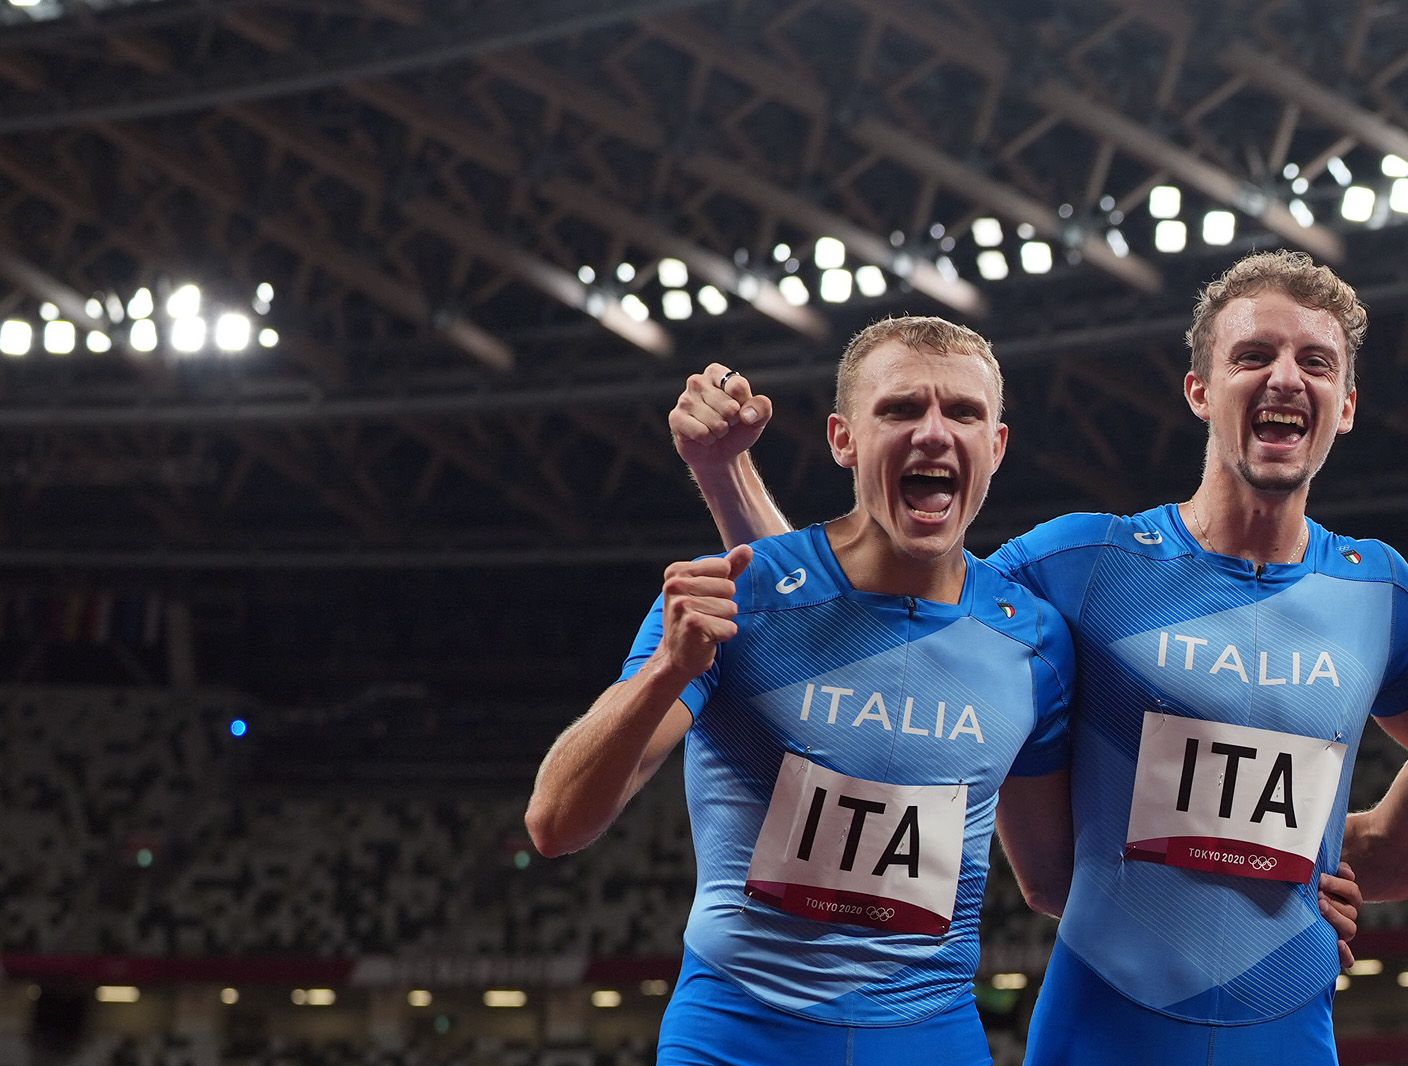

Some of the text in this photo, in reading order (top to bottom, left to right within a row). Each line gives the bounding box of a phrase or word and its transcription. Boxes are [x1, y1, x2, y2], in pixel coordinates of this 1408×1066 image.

[1156, 630, 1341, 688] ITALIA
[799, 682, 985, 744] ITALIA
[1175, 737, 1299, 829] ITA
[796, 785, 920, 878] ITA
[1188, 847, 1245, 865] TOKYO 2020
[805, 896, 863, 915] TOKYO 2020
